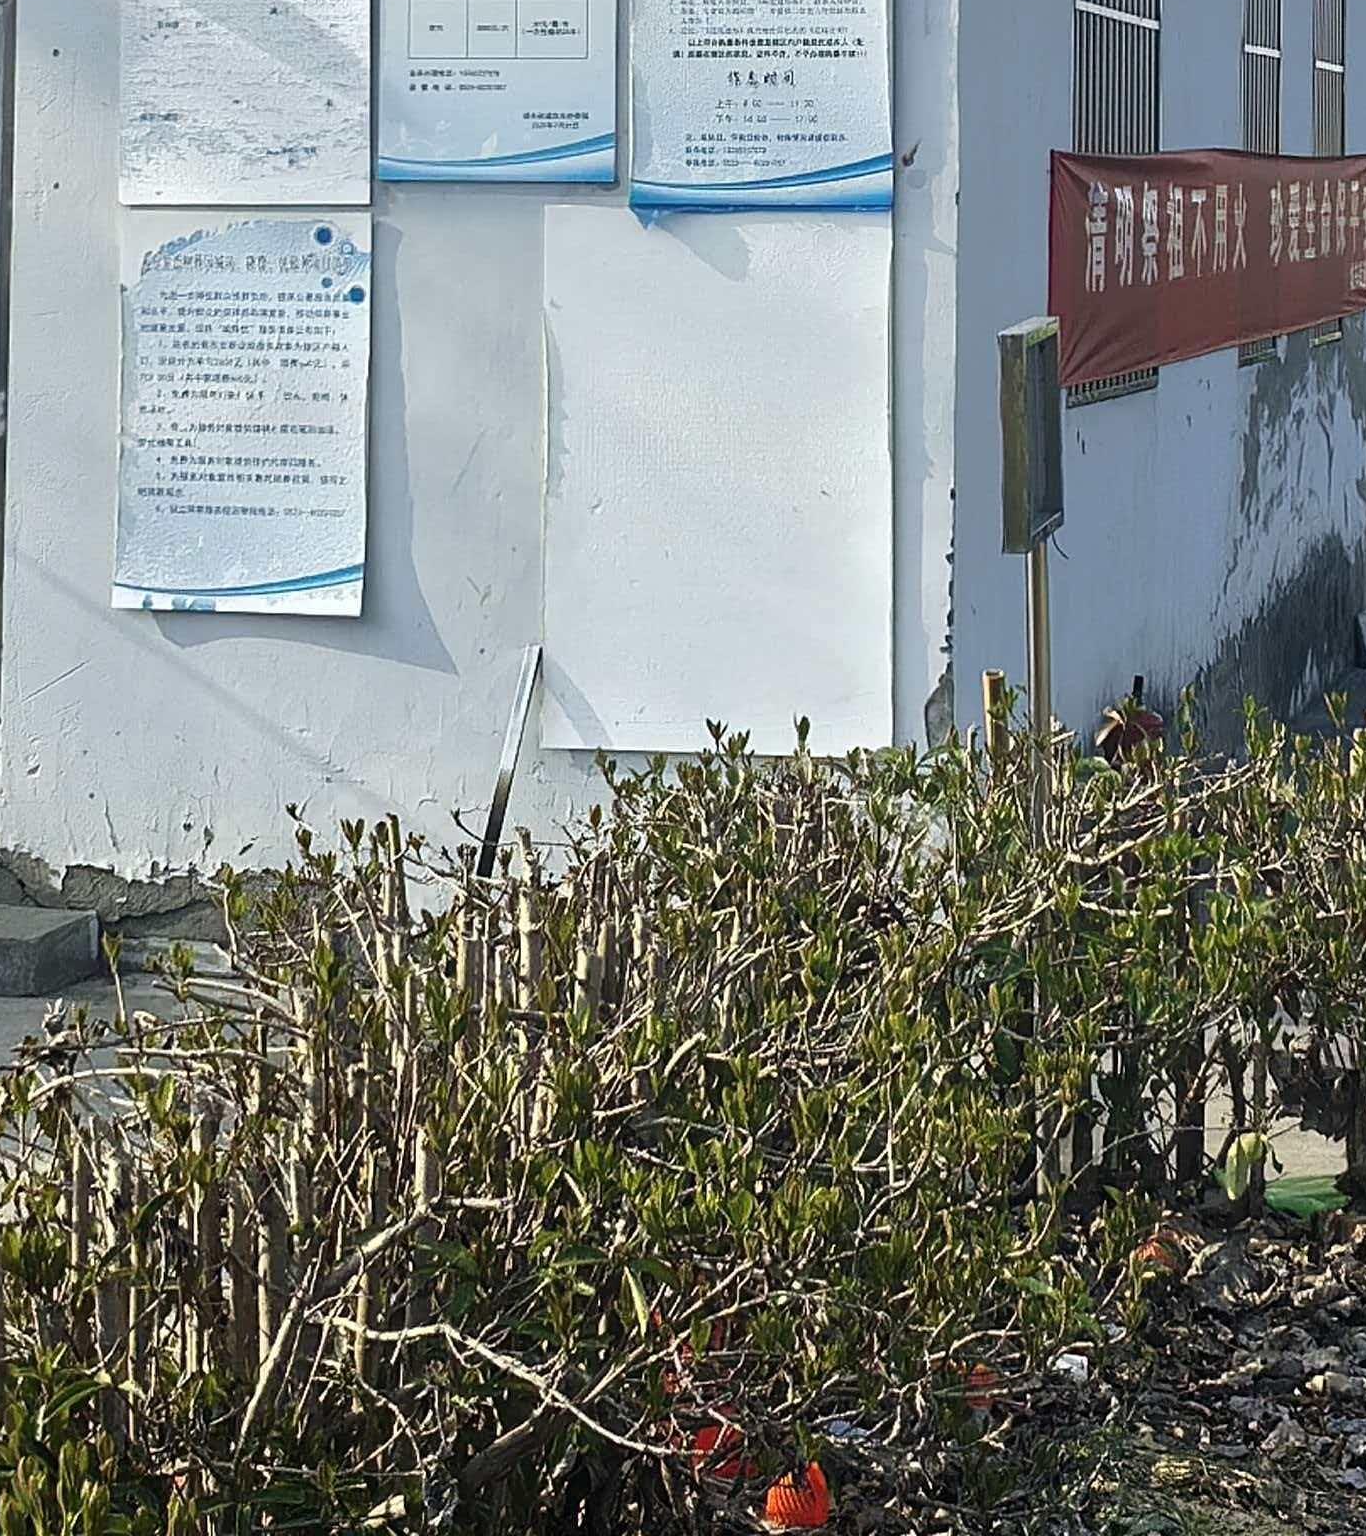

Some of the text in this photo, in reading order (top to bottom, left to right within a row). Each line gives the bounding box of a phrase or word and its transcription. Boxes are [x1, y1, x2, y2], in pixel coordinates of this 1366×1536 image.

[728, 70, 796, 86] 作息时间
[1085, 180, 1247, 292] 清明祭祖不用火
